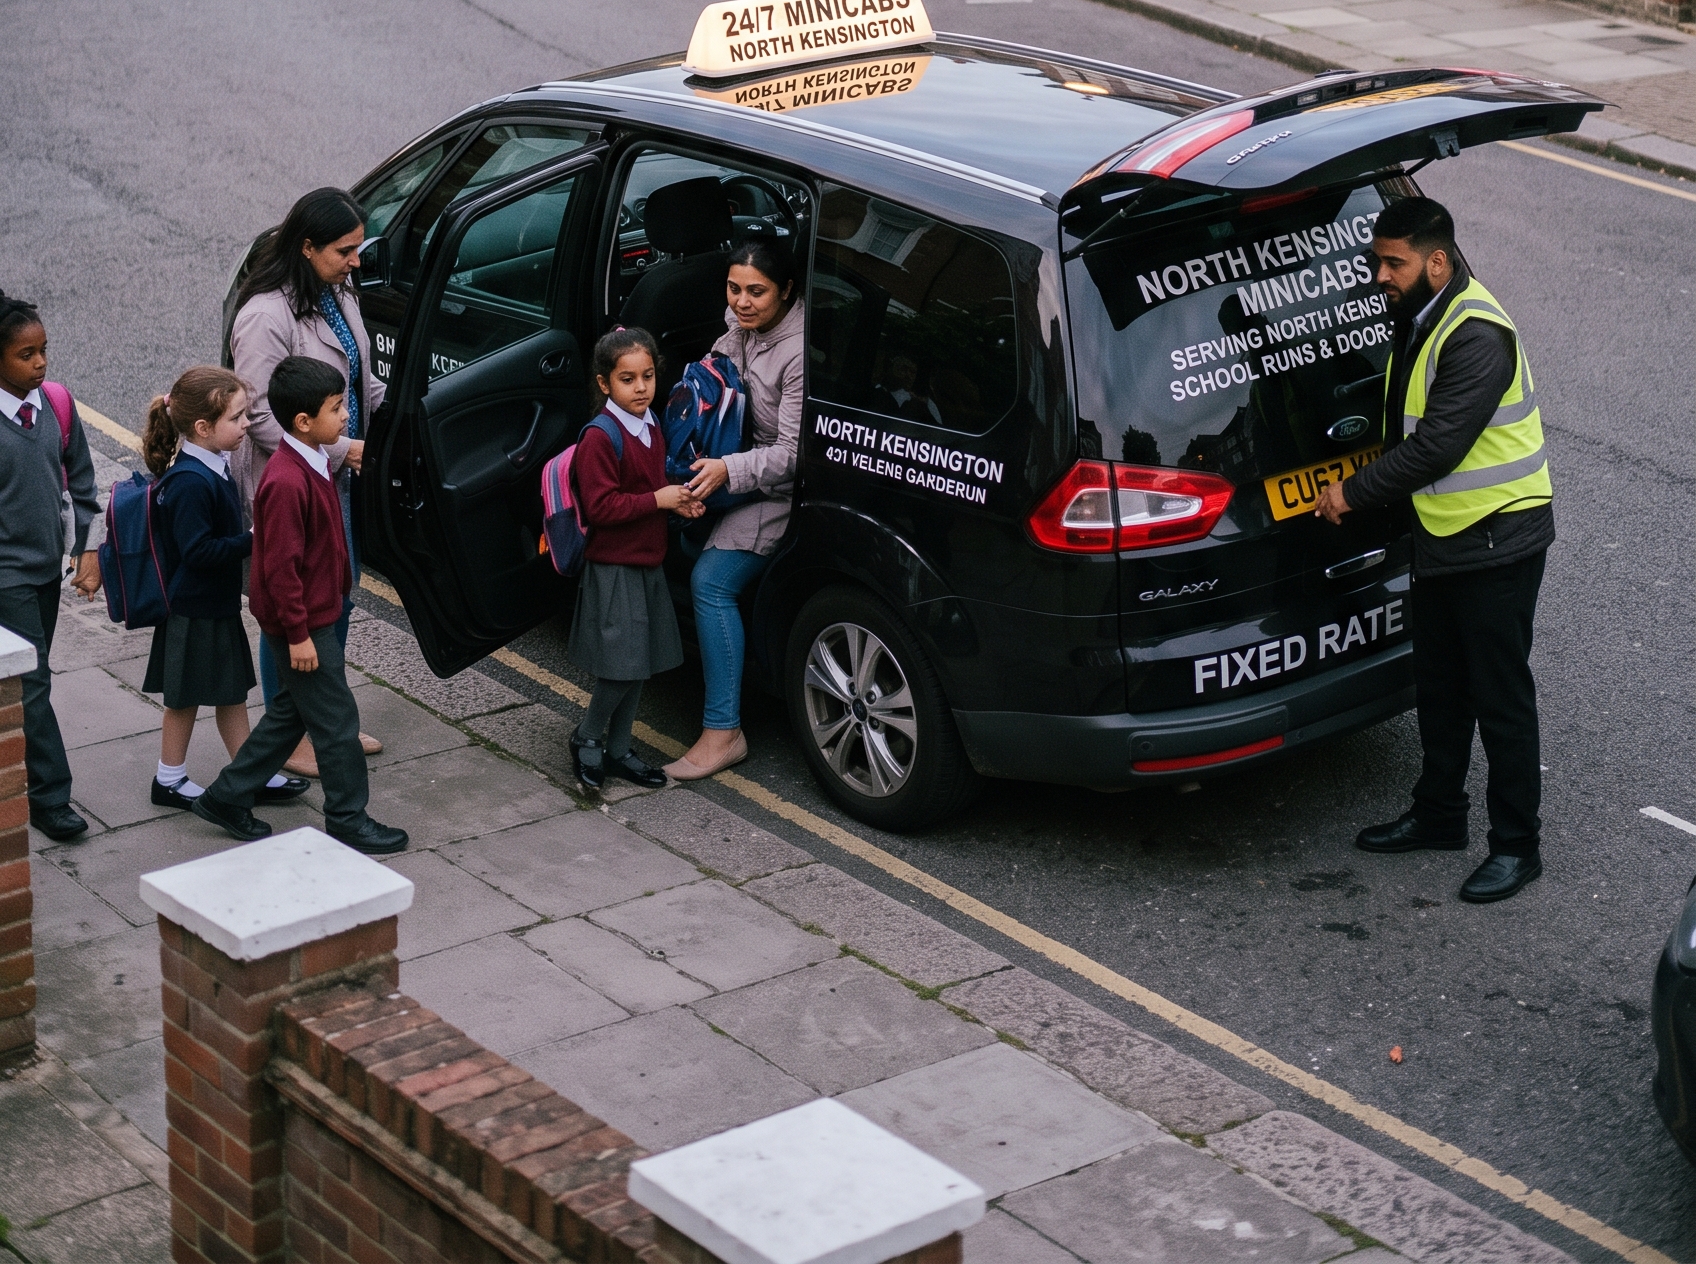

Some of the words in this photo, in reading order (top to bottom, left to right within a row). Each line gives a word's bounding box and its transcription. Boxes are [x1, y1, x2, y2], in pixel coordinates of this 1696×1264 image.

[722, 5, 775, 38] 24/7
[729, 34, 795, 62] NORTH
[800, 15, 916, 57] KENSINGTON
[1136, 246, 1252, 304] NORTH
[1236, 254, 1372, 317] MINICABS
[1169, 361, 1260, 402] SCHOOL
[1261, 342, 1316, 376] RUNS
[1319, 338, 1334, 359] &
[1335, 321, 1395, 354] DOOR-
[1170, 328, 1263, 371] SERVING
[1265, 308, 1333, 345] NORTH
[1334, 292, 1388, 325] KENSI
[815, 414, 877, 449] NORTH
[880, 432, 1004, 484] KENSINGTON
[1139, 578, 1219, 601] GALAXY
[1194, 635, 1307, 694] FIXED
[1319, 599, 1404, 660] RATE
